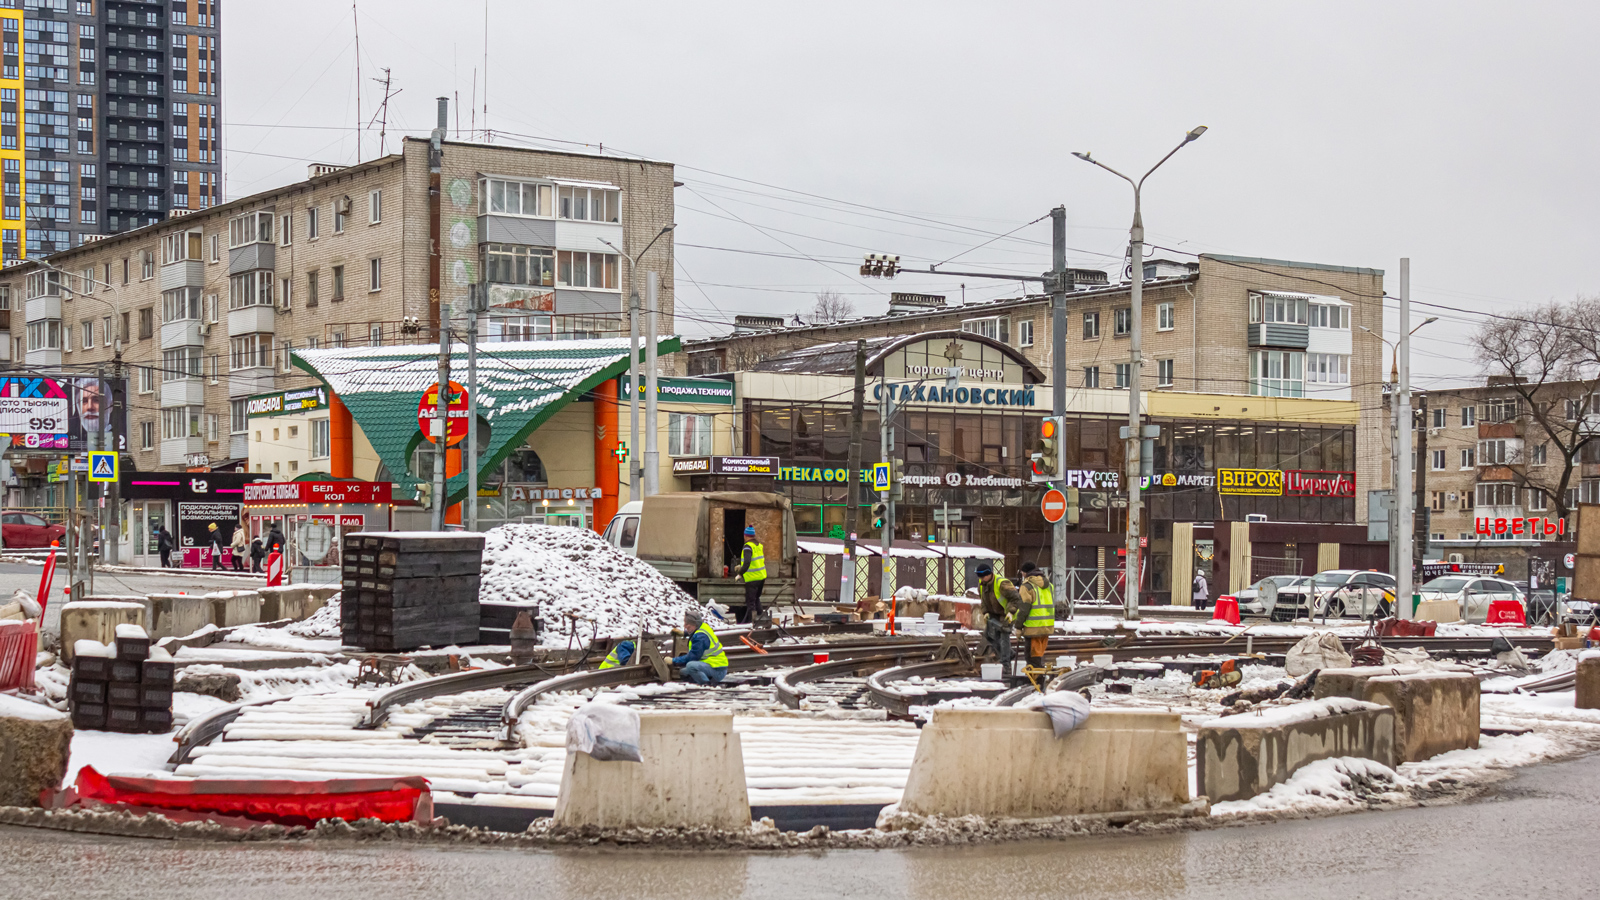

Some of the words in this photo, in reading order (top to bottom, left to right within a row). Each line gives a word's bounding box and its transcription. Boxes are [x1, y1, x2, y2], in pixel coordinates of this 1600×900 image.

[907, 364, 966, 377] торговй
[969, 369, 1004, 381] центр
[661, 386, 698, 395] ПРОДАЖА
[698, 387, 732, 396] ТЕХНИКИ
[873, 384, 1035, 406] СТАХАНОВСКИЙ
[246, 397, 281, 414] ЛОМБАРД
[673, 460, 707, 471] ЛОМБАРД
[722, 457, 770, 466] Комиссионный
[191, 478, 208, 493] t2
[965, 474, 1022, 488] Хлебница
[1176, 474, 1216, 487] МАРКЕТ
[1221, 471, 1280, 487] ВПРОК
[244, 484, 276, 500] БЕЛОРУССКИЕ
[511, 487, 602, 500] Аптека
[341, 518, 360, 526] САЛО
[1475, 517, 1565, 536] ЦВЕТЫ
[183, 536, 194, 546] t2
